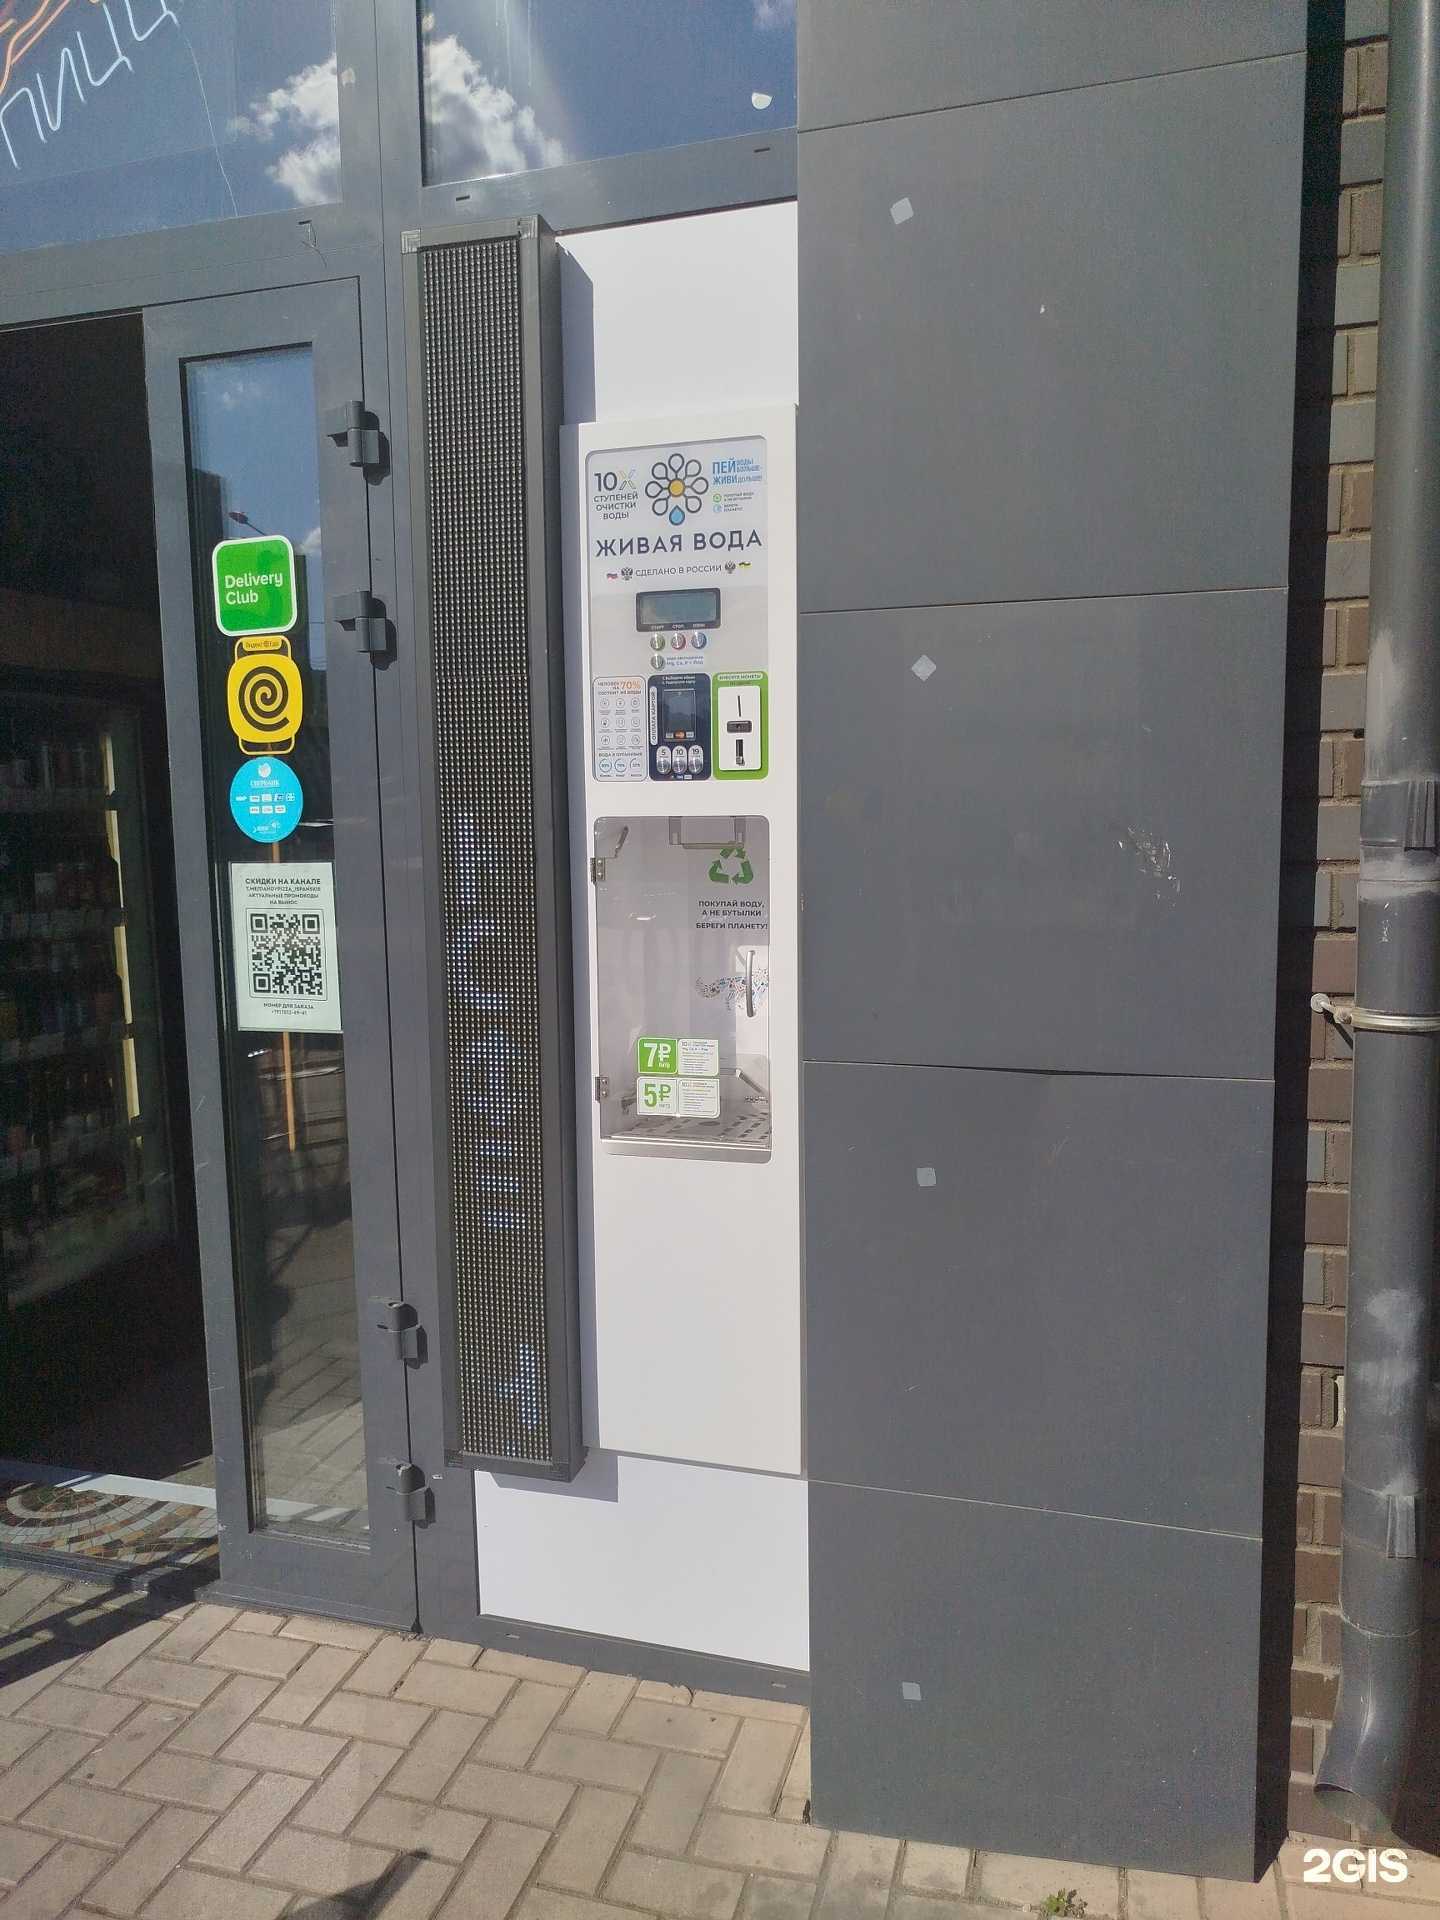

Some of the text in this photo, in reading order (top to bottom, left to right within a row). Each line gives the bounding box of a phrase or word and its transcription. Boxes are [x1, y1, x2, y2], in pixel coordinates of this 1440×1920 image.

[712, 456, 736, 474] ПЕЙ
[593, 492, 639, 503] СТУПЕНЕЙ
[595, 502, 637, 512] ОЧИСТКИ
[602, 511, 630, 520] ВОДЫ
[596, 529, 762, 557] ЖИВАЯ ВОДА
[635, 567, 677, 577] СДЕЛАНО
[687, 565, 722, 574] РОССИИ
[225, 572, 283, 588] Delivery
[226, 590, 259, 605] Club
[621, 680, 641, 690] 70%
[698, 900, 738, 908] ПОКУПАЙ
[722, 909, 762, 917] БУТЫЛКИ
[727, 922, 768, 930] ПЛАНЕТУ!
